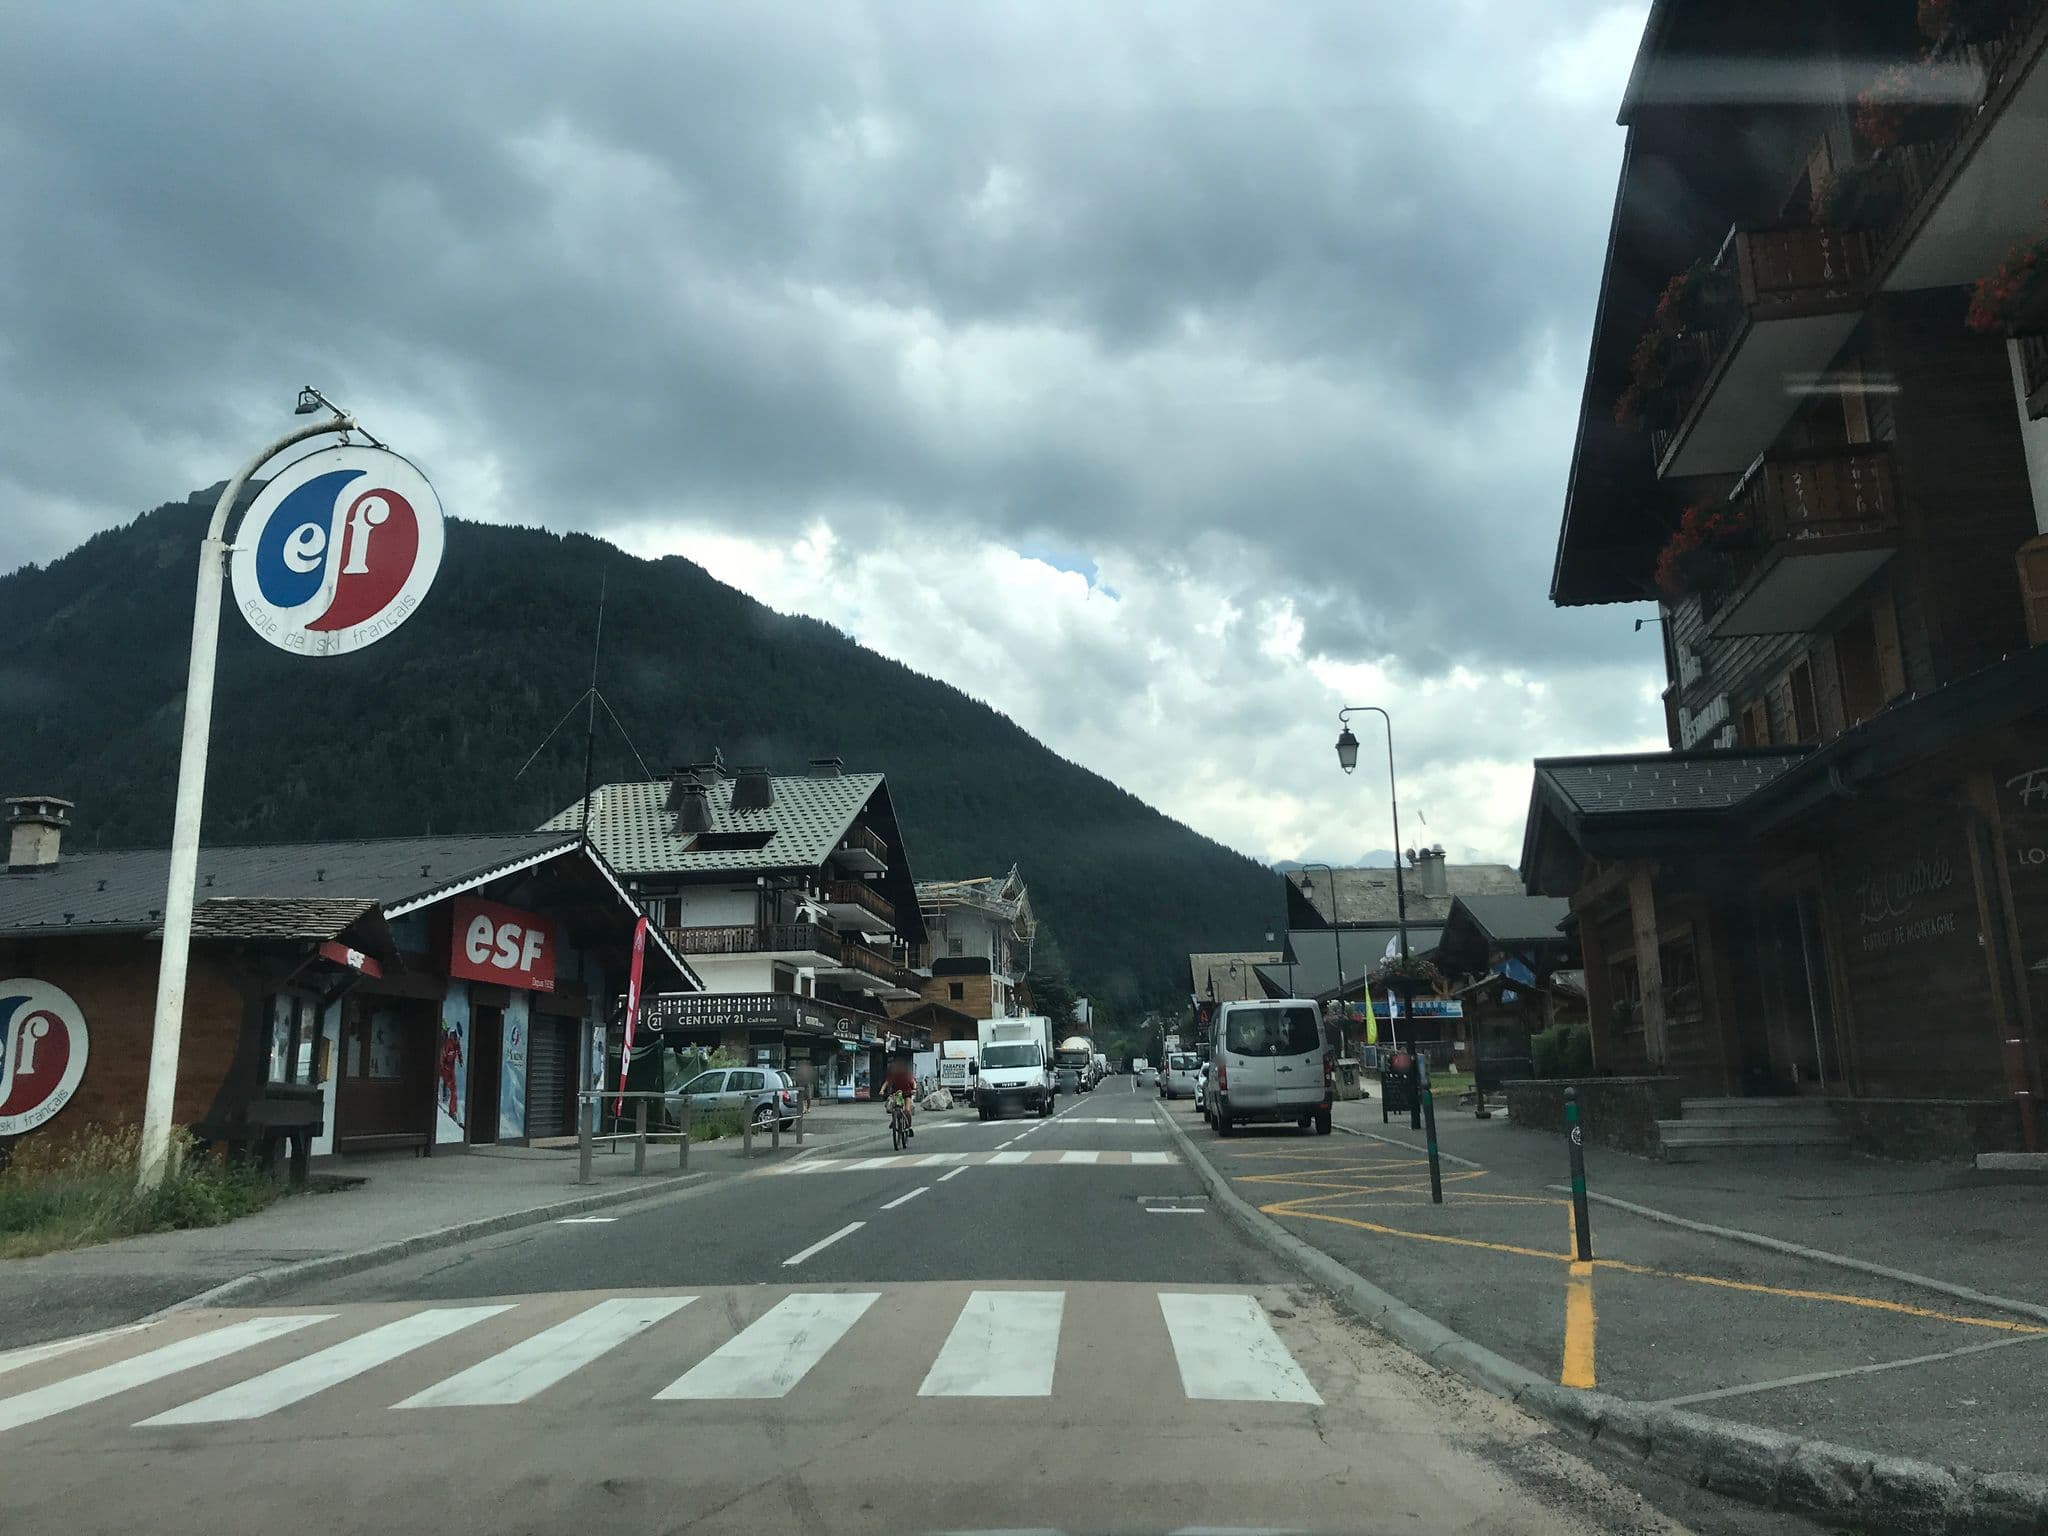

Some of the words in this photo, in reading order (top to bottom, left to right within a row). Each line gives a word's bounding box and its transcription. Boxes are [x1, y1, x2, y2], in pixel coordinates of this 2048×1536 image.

[244, 599, 278, 635] ecole
[283, 631, 304, 649] de
[316, 636, 340, 652] ski
[352, 593, 416, 645] français
[678, 1014, 732, 1025] CENTURY
[734, 1014, 744, 1024] 21
